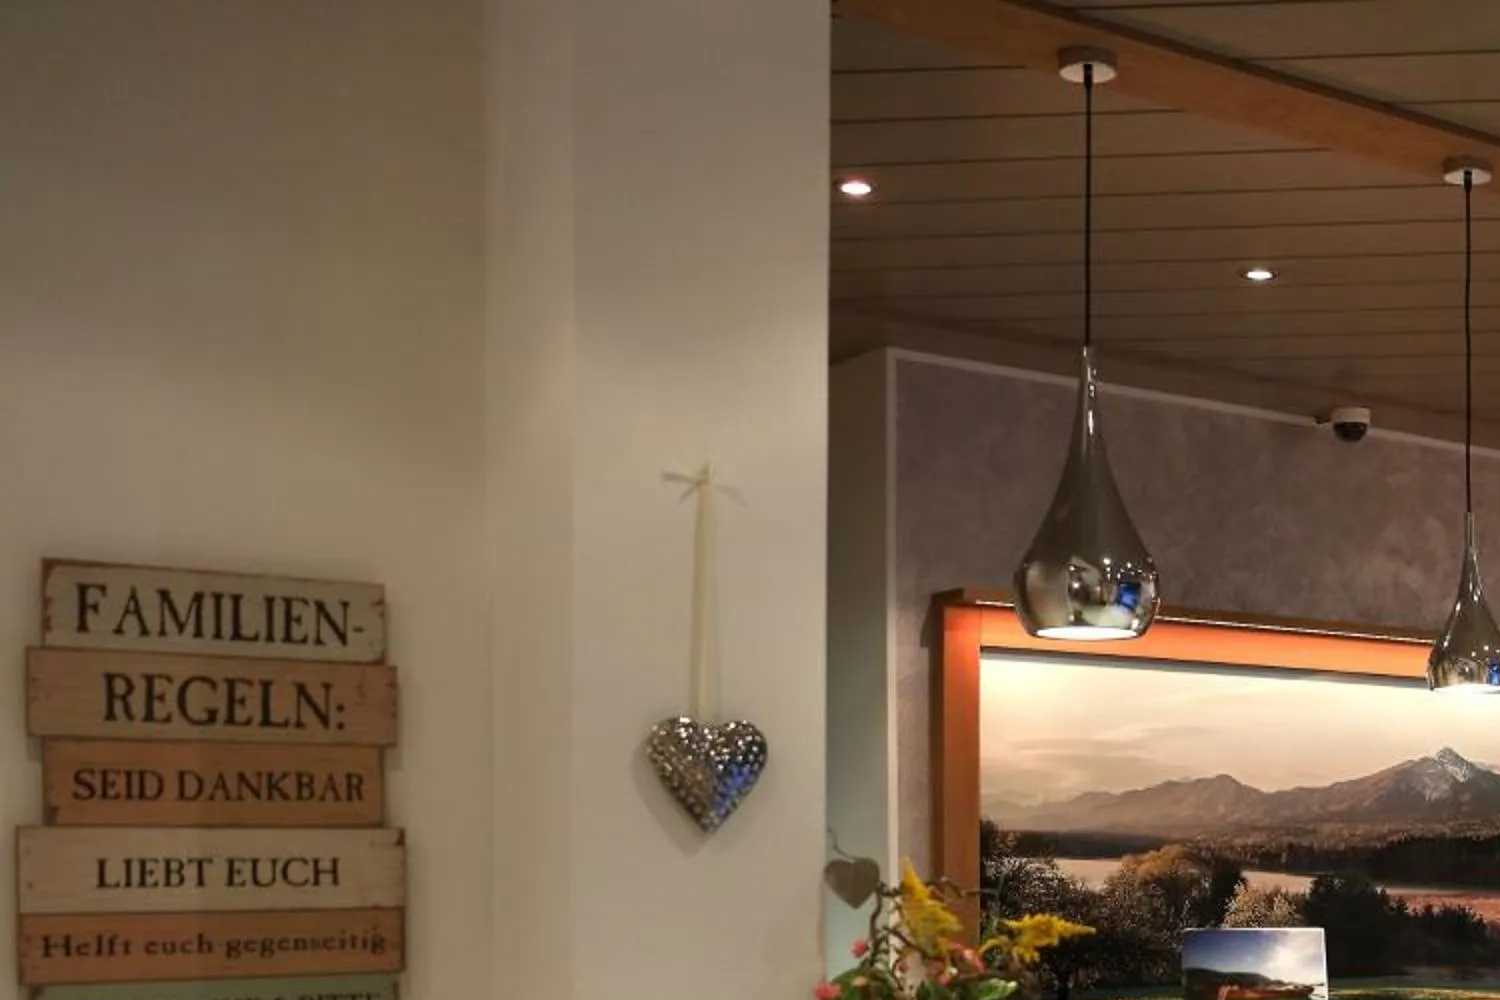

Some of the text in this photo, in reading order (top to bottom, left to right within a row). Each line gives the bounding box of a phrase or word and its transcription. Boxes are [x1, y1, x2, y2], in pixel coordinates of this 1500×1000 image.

[75, 581, 364, 646] FAMILIEN-
[103, 671, 346, 730] REGELN:
[72, 768, 364, 801] SEID DANKBAR
[96, 857, 340, 889] LIEBT EUCH
[41, 926, 387, 960] Helft euch gegenseitig
